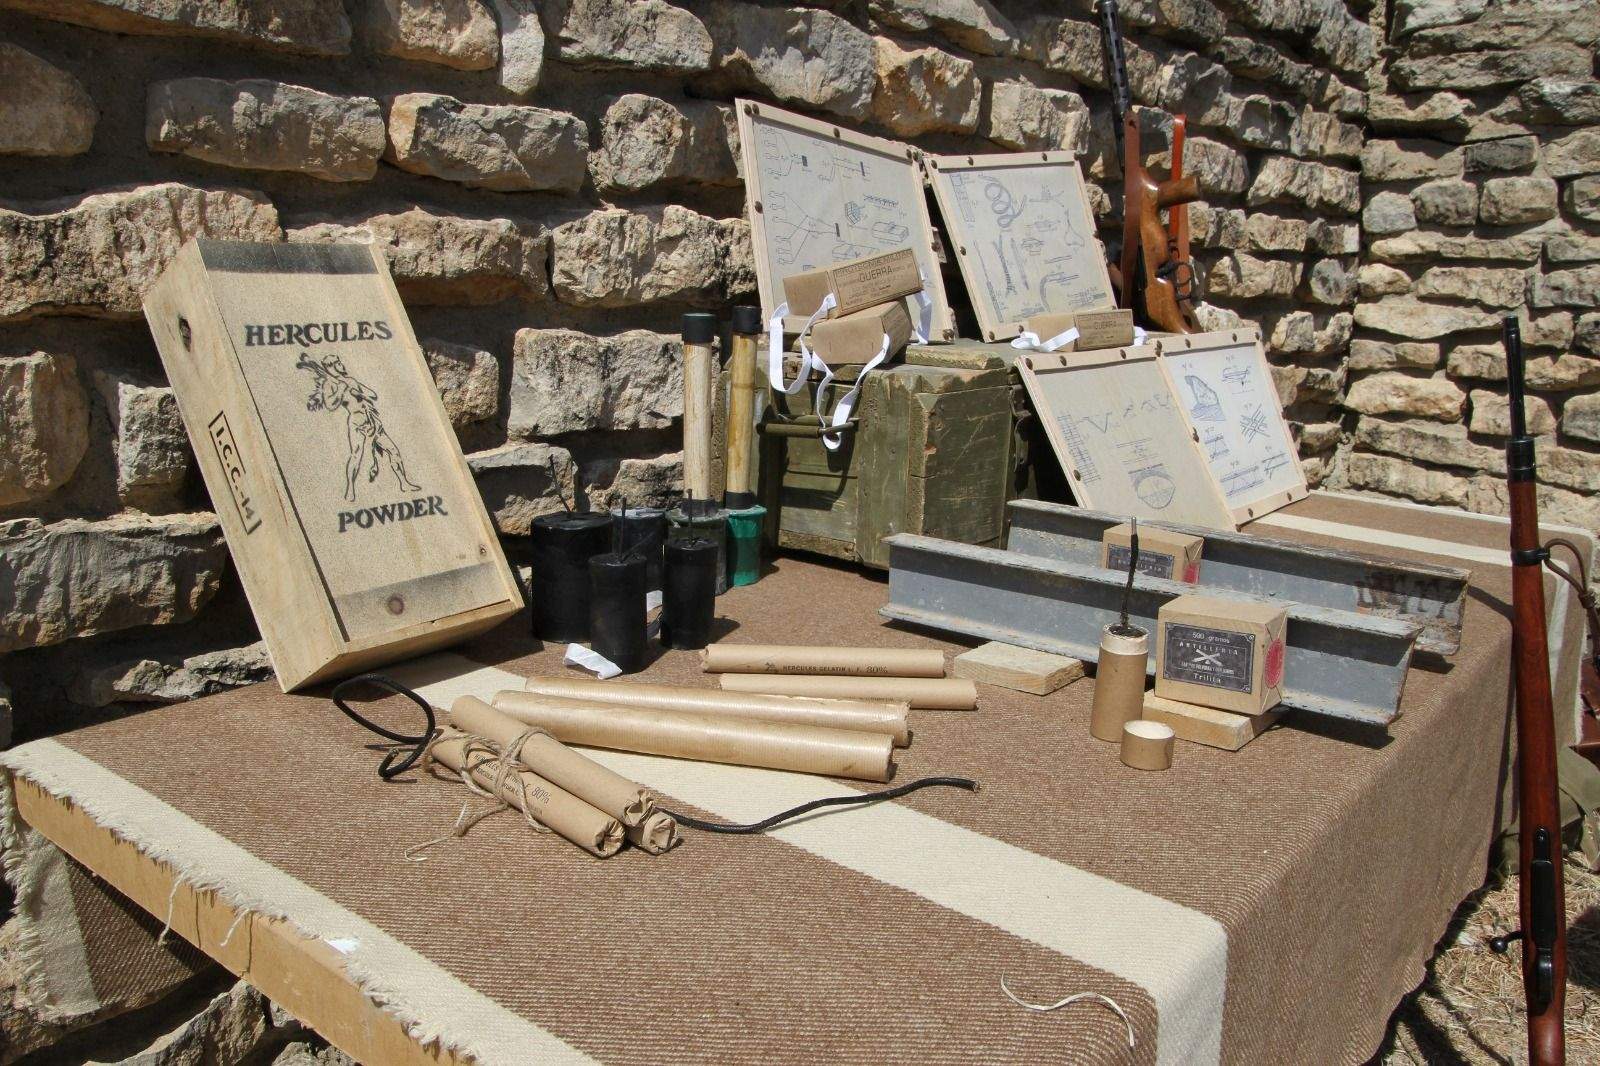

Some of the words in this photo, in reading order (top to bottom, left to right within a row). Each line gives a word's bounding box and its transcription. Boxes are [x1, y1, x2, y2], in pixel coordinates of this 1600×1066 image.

[859, 265, 893, 283] GUERRA
[244, 320, 393, 348] HERCULES
[337, 495, 448, 533] POWDER
[1208, 635, 1230, 644] gramos
[531, 786, 552, 805] 80%
